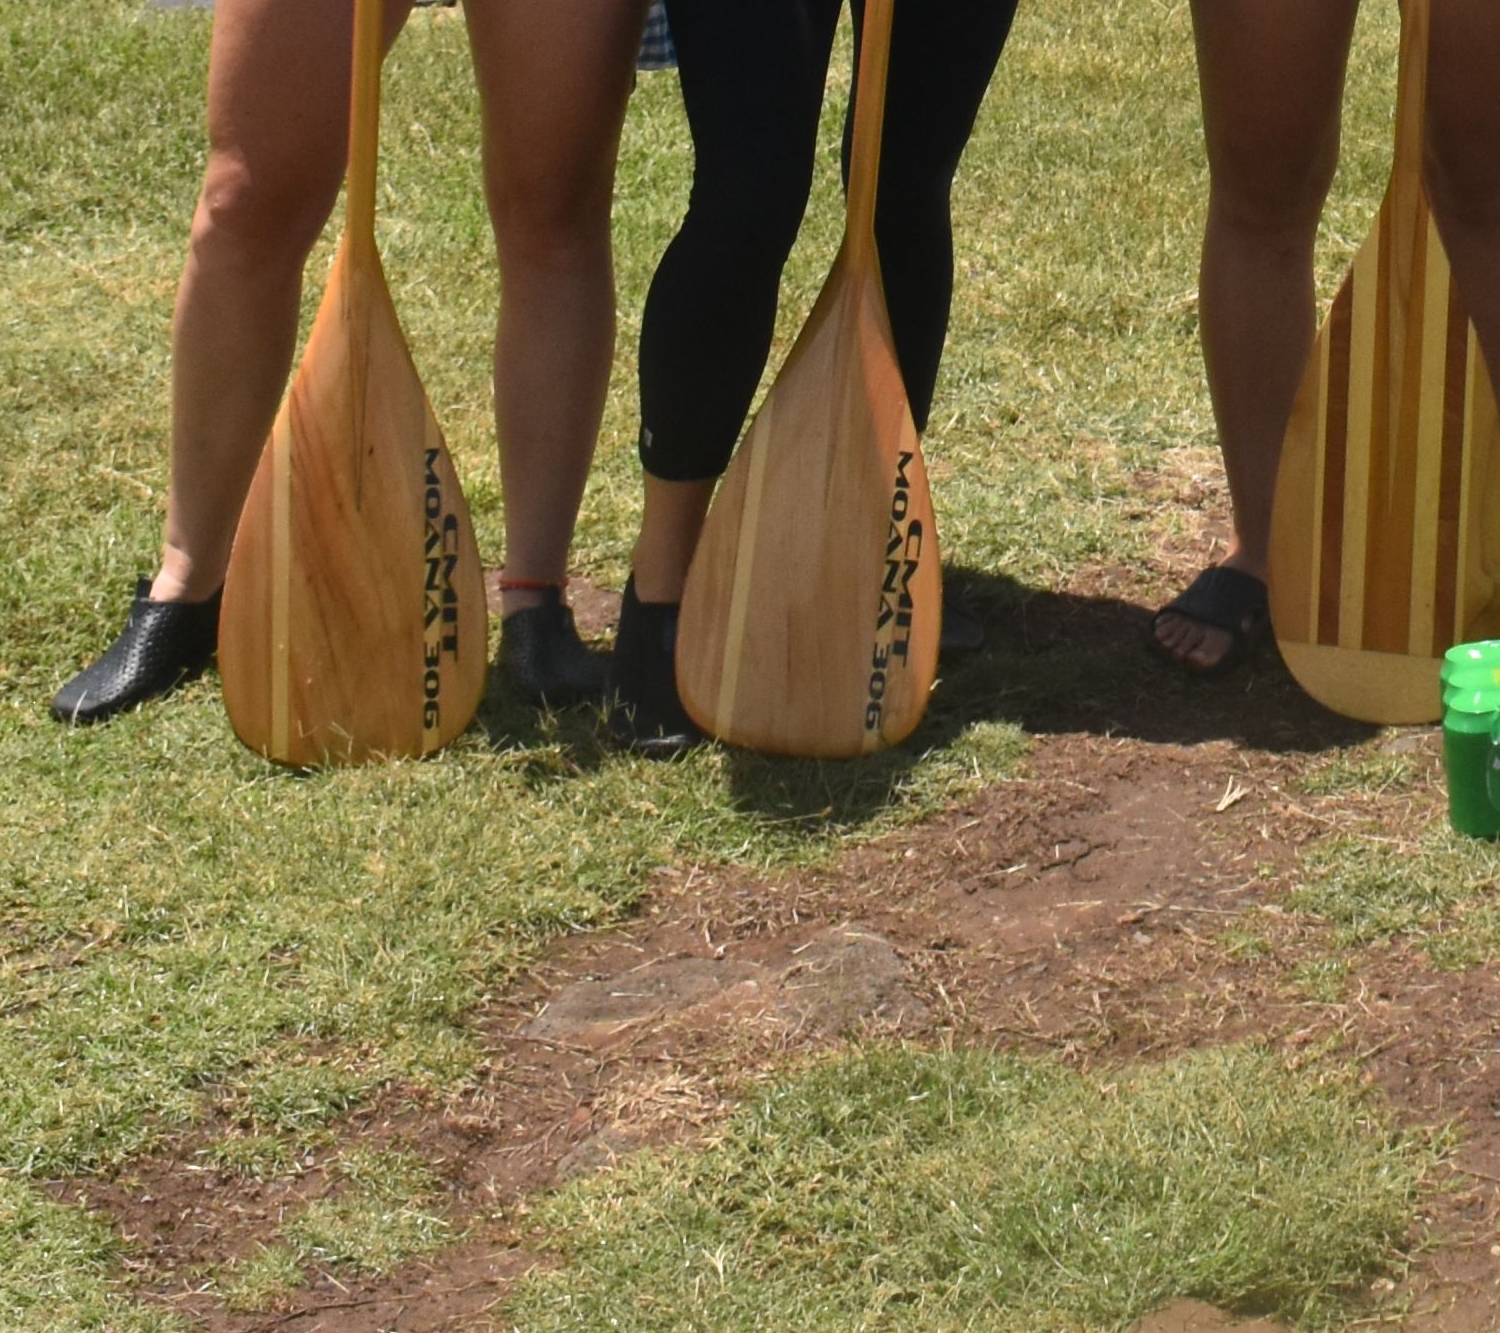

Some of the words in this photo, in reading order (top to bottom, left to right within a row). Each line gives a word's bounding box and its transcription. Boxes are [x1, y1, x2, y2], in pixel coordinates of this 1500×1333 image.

[425, 448, 441, 630] MOANA
[442, 513, 459, 662] CMIT
[876, 451, 914, 631] MOANA
[892, 519, 923, 668] CMIT
